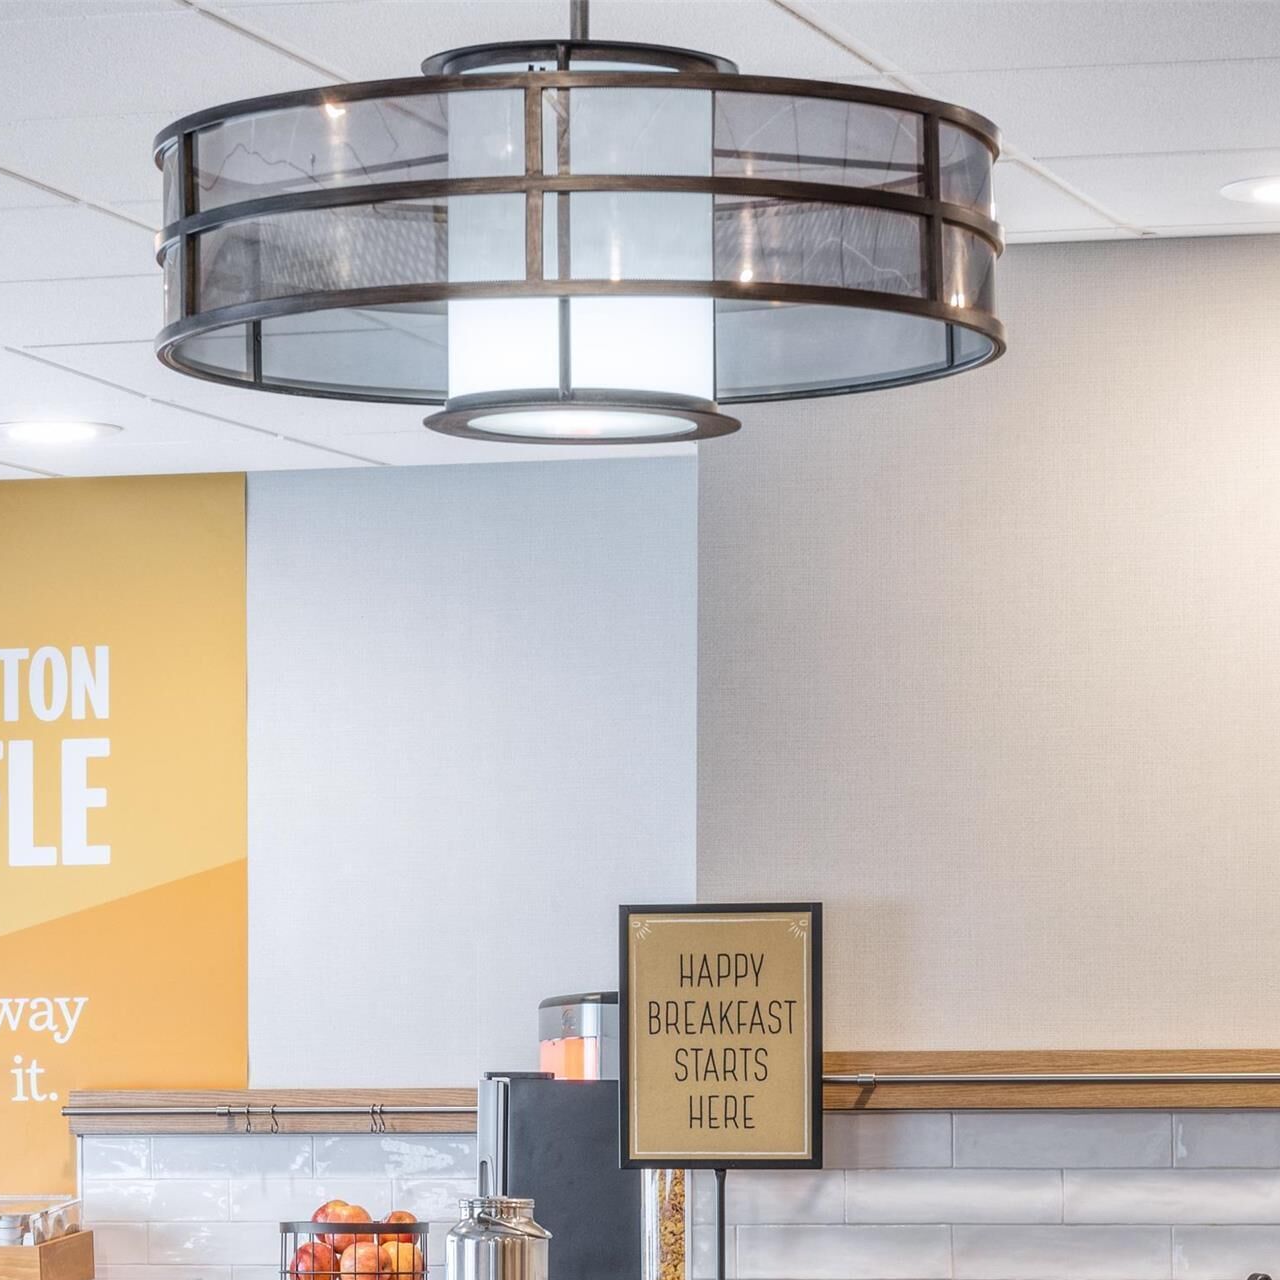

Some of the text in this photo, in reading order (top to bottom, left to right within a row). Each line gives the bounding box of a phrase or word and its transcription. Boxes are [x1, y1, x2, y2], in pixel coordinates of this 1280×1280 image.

[679, 953, 765, 988] HAPPY
[648, 999, 797, 1035] BREAKFAST
[10, 1054, 59, 1102] it.
[674, 1047, 769, 1082] STARTS
[689, 1095, 756, 1129] HERE
